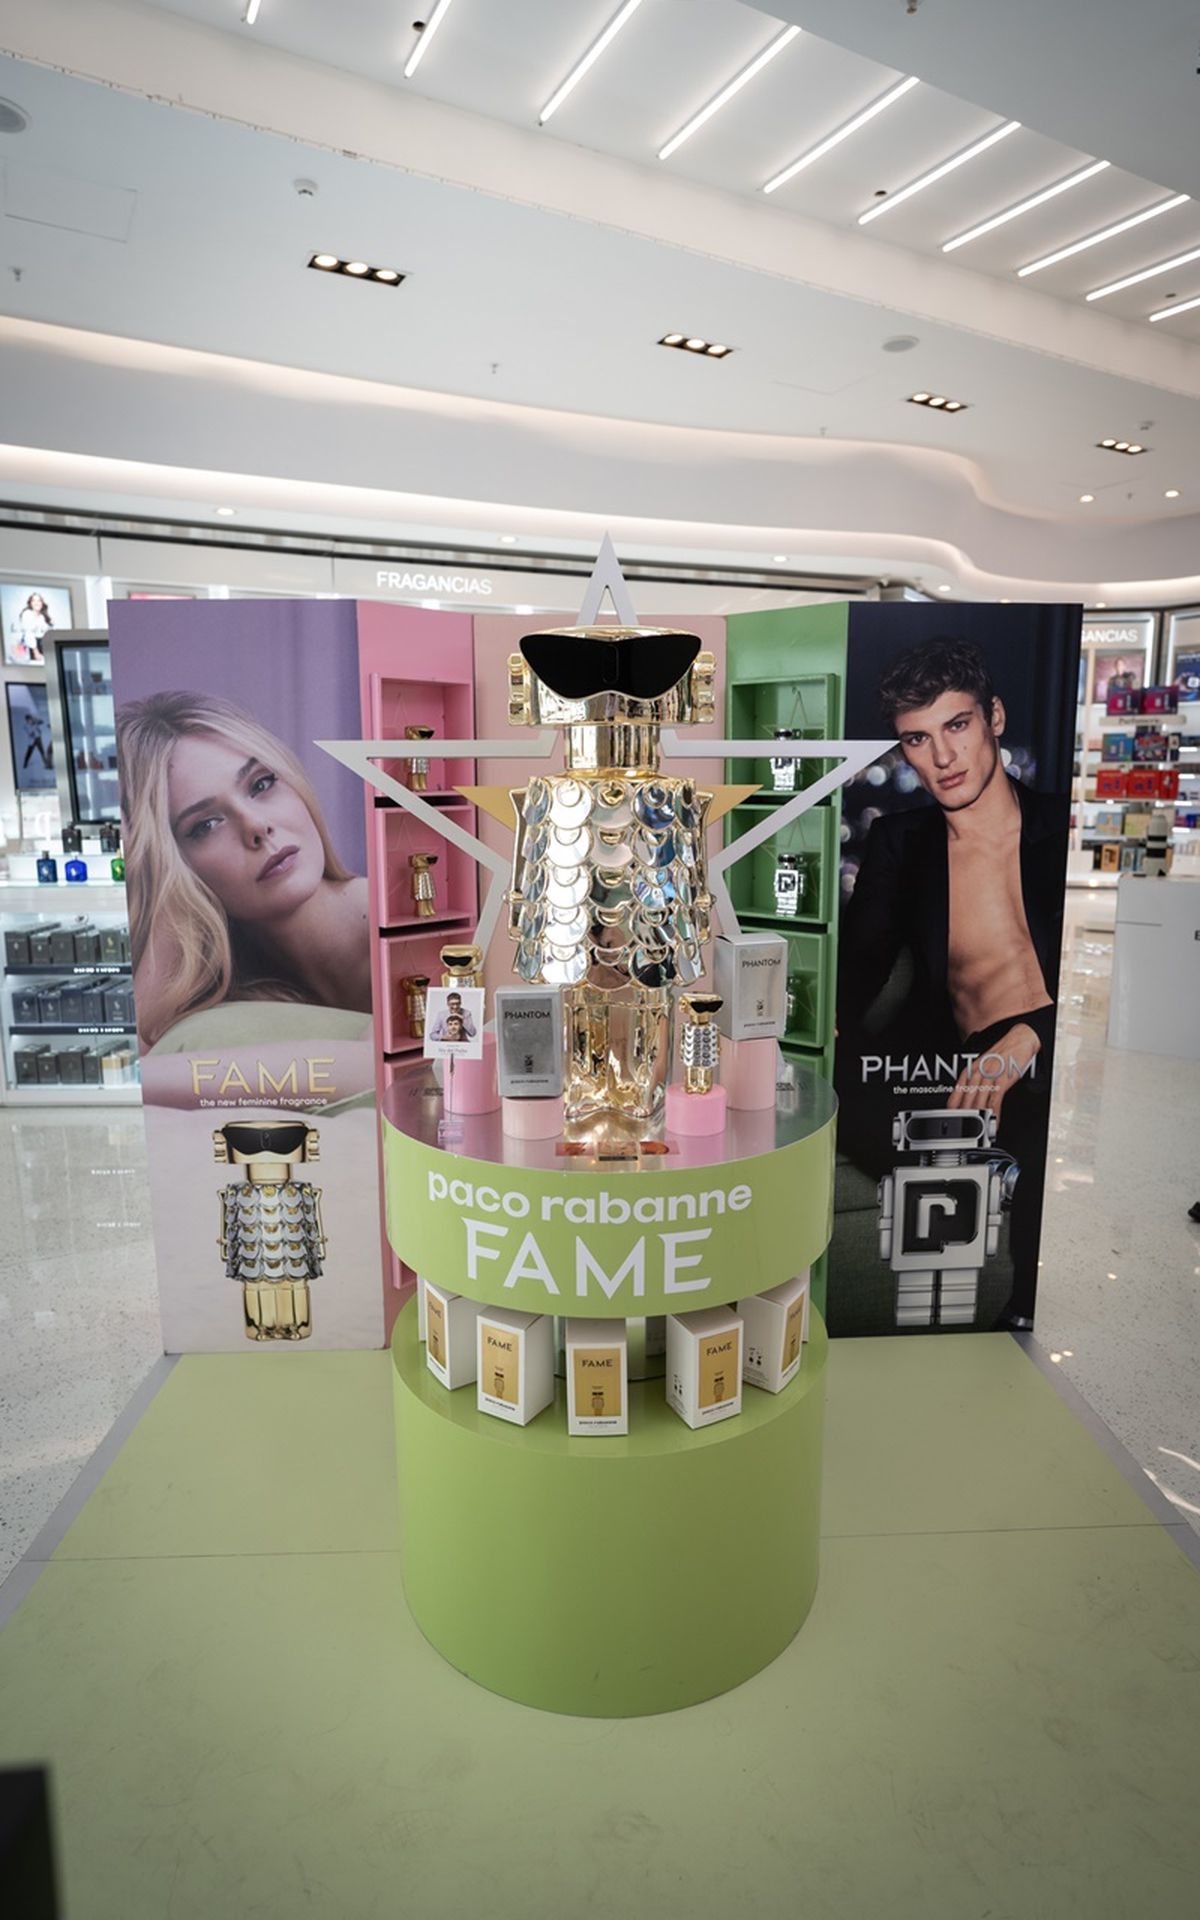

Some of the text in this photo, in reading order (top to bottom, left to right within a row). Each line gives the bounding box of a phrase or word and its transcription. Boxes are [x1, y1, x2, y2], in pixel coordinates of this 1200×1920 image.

[376, 571, 493, 595] FRAGANCIAS
[742, 958, 781, 969] PHANTOM
[504, 1010, 551, 1020] PHANTOM
[860, 1052, 1037, 1083] PHANTOM
[188, 1057, 337, 1095] FAME
[893, 1086, 908, 1095] the
[909, 1085, 954, 1095] masculine
[200, 1098, 216, 1107] the
[238, 1098, 279, 1107] feminine
[280, 1097, 328, 1108] fragrance
[428, 1170, 753, 1225] paco rabanne
[461, 1216, 713, 1300] FAME
[487, 1335, 512, 1352] FAME
[706, 1340, 732, 1356] FAME
[582, 1359, 613, 1368] FAME
